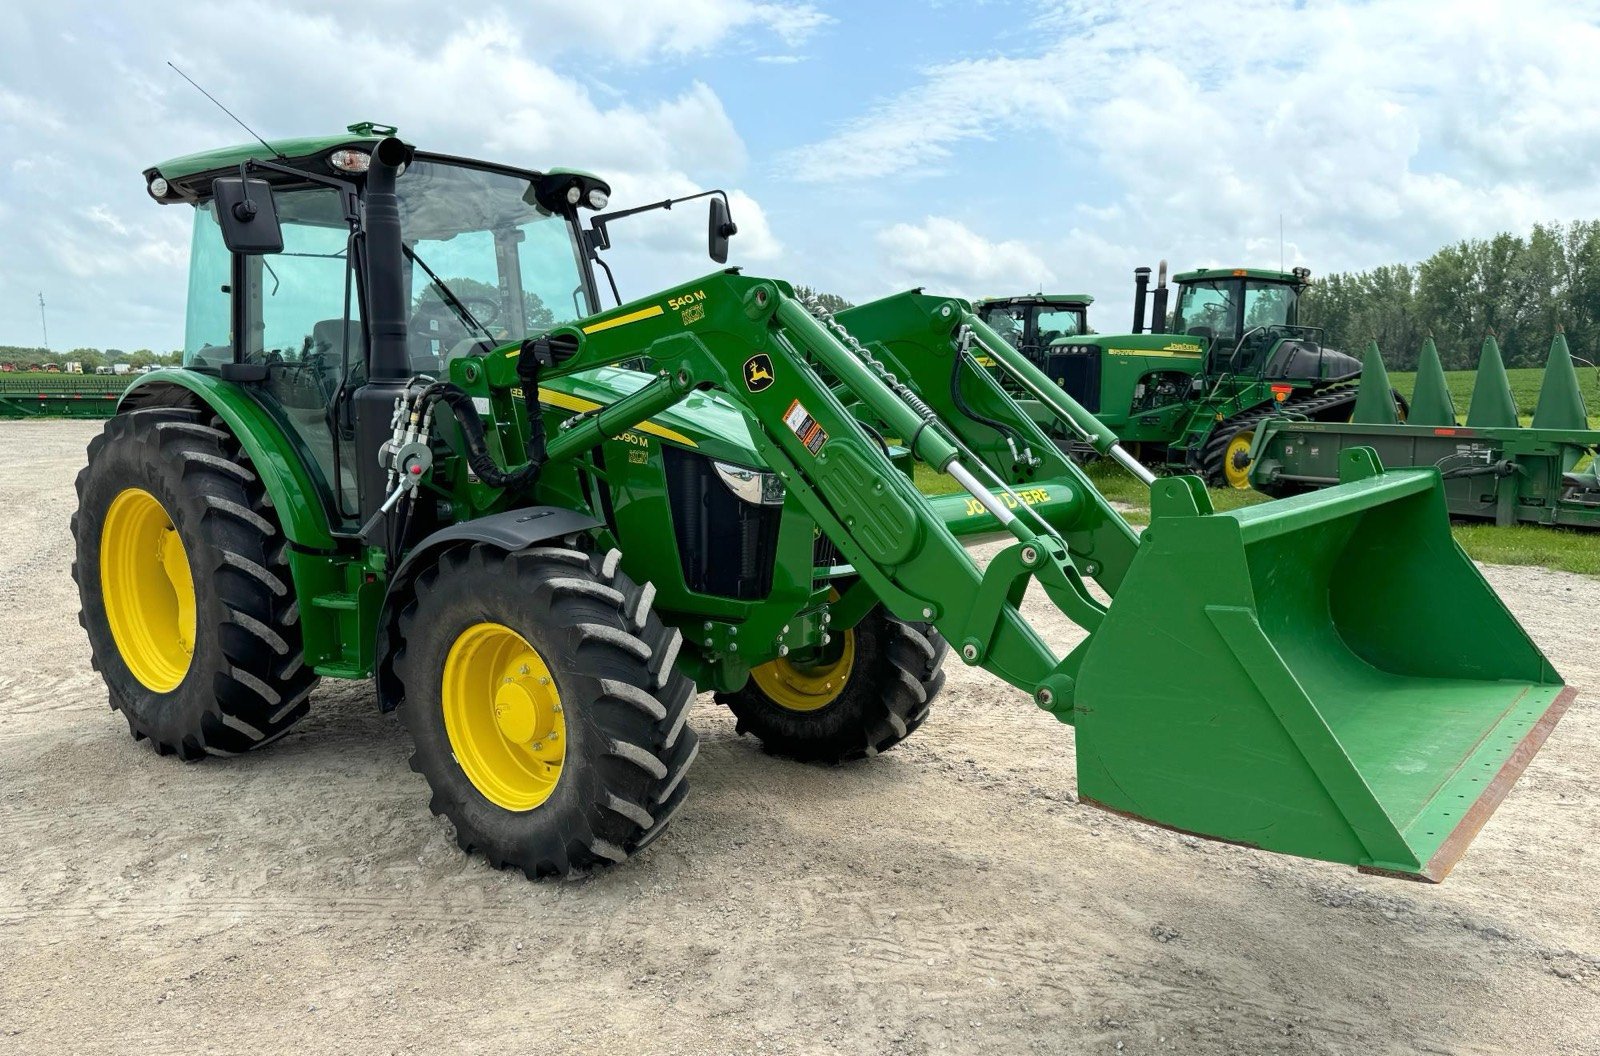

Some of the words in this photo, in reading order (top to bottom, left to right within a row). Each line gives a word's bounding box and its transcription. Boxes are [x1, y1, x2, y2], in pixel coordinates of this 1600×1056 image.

[668, 294, 694, 310] 540
[693, 290, 707, 301] M
[639, 437, 649, 448] M
[1001, 488, 1052, 509] DERE
